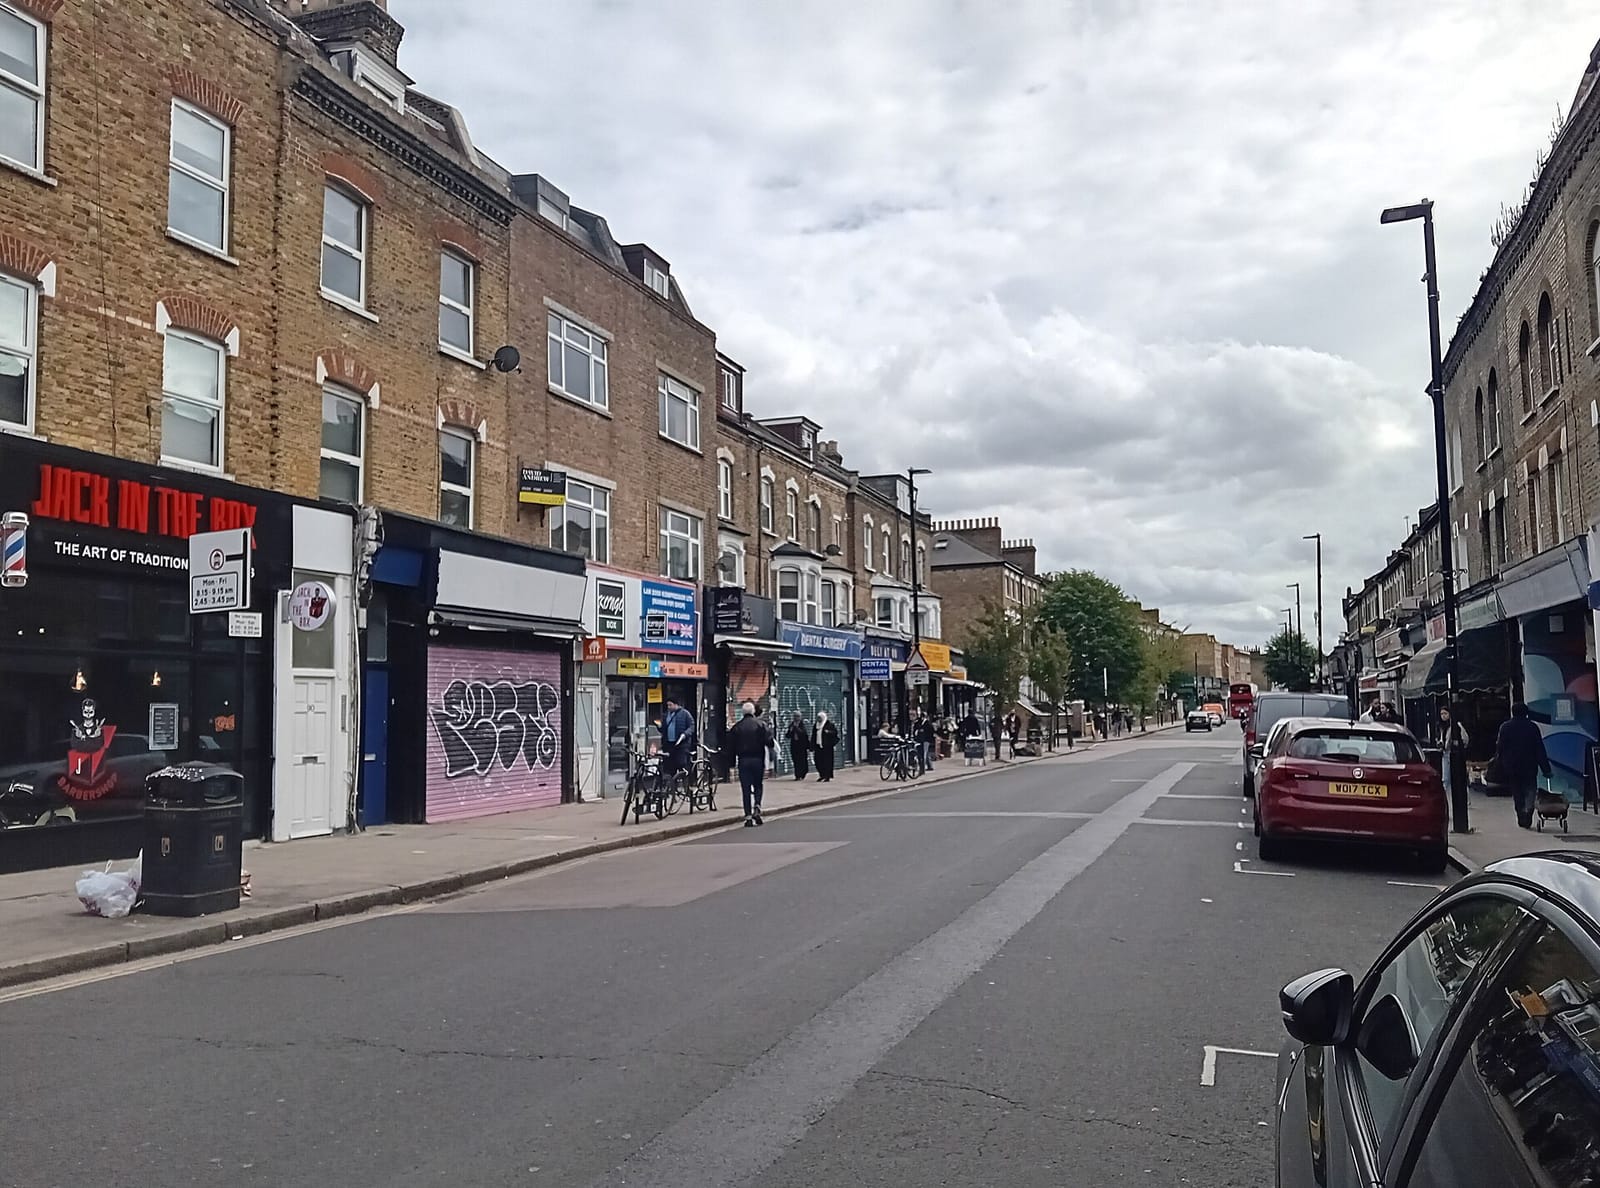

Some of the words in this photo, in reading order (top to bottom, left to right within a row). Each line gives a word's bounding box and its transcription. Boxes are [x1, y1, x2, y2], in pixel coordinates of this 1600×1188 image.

[32, 464, 109, 528] JACK
[117, 479, 150, 534] IN
[155, 486, 203, 539] THE
[54, 541, 79, 557] THE
[82, 545, 107, 560] ART
[110, 549, 126, 562] OF
[801, 633, 823, 648] DENTAL
[823, 637, 848, 651] SURGERY
[75, 758, 81, 774] J
[57, 772, 117, 800] BARBERSHOP
[1362, 785, 1381, 795] TCX
